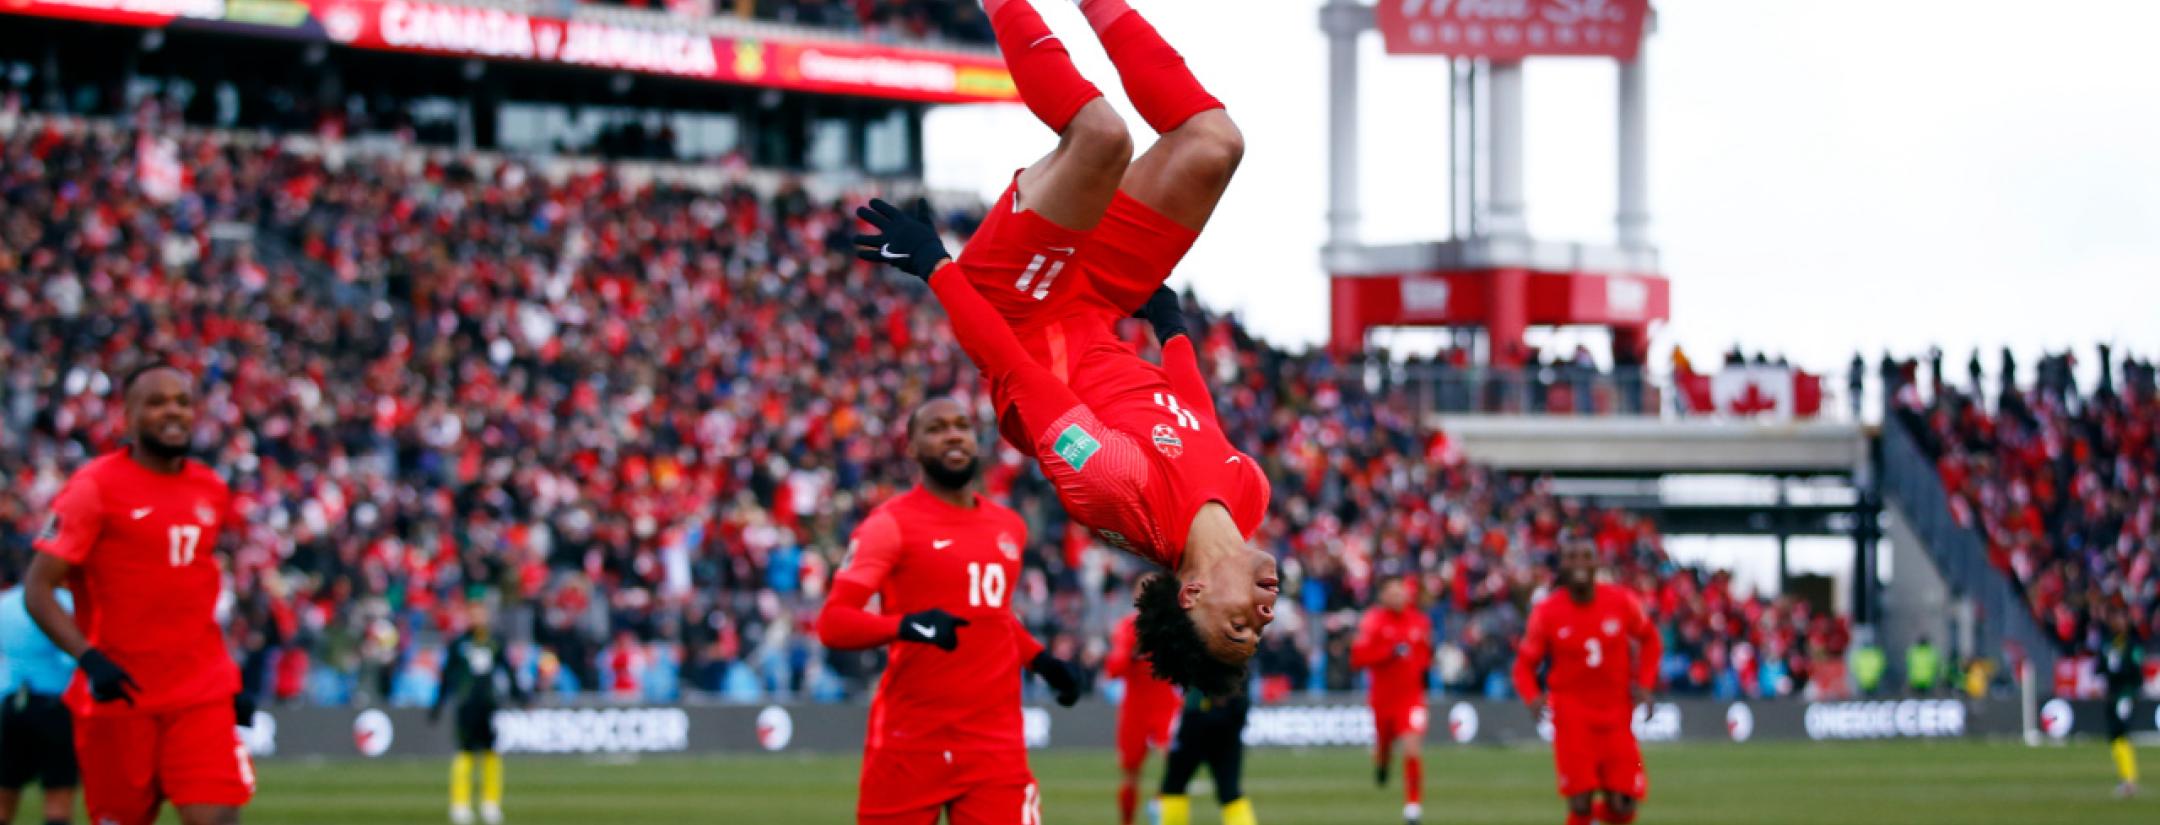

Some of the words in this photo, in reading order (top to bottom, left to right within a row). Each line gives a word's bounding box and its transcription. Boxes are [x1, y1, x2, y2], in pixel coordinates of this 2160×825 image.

[1015, 254, 1065, 300] 11
[168, 525, 201, 567] 17
[967, 561, 1006, 607] 10
[1583, 637, 1602, 668] 3
[1805, 699, 1965, 740] ONESOCCER
